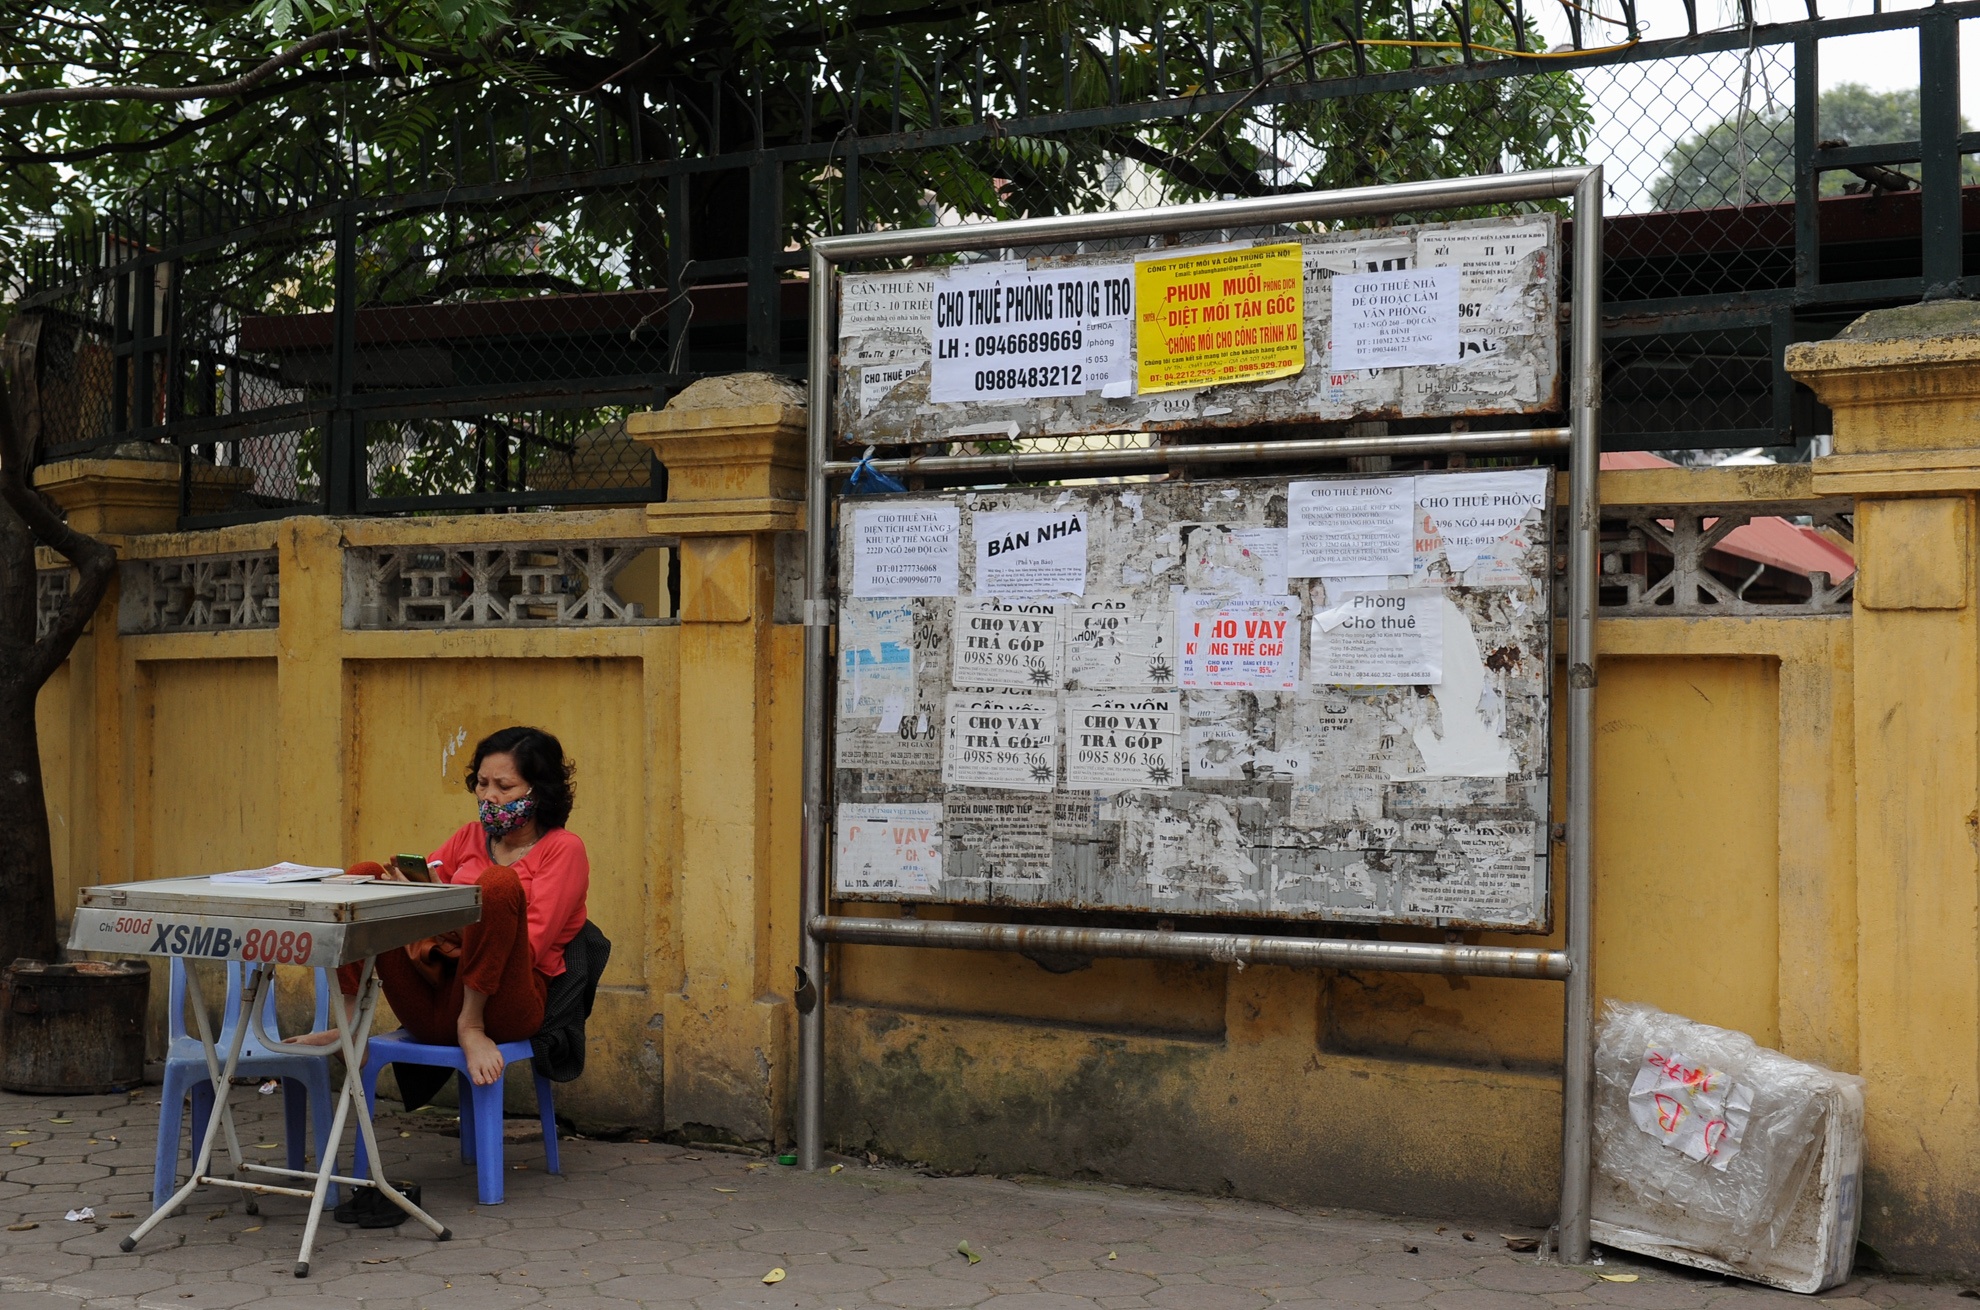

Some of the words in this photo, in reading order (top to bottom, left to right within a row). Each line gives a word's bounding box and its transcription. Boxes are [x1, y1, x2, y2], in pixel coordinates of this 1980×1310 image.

[1484, 246, 1494, 256] TI
[1504, 246, 1515, 255] VI
[1147, 264, 1167, 274] CÔNG
[880, 280, 914, 294] THUÊ
[1166, 282, 1211, 304] PHUN
[1223, 270, 1262, 297] MUỖI
[1306, 286, 1318, 294] 514
[1354, 283, 1378, 294] CHO
[1380, 278, 1411, 292] THUÊ
[1413, 276, 1436, 289] NHÀ
[937, 290, 964, 328] CHO
[968, 280, 1001, 326] THUÊ
[1006, 276, 1053, 323] PHÒNG
[1058, 280, 1084, 327] TRỌ
[1414, 290, 1439, 302] LÀM
[874, 302, 880, 312] 3
[890, 302, 900, 311] 10
[1168, 306, 1199, 328] DIỆT
[1202, 298, 1230, 323] MỐI
[1234, 297, 1262, 322] TẬN
[1266, 290, 1296, 316] GỐC
[1363, 307, 1386, 318] VĂN
[1388, 304, 1428, 317] PHÒNG
[1458, 302, 1482, 318] 967
[939, 339, 959, 360] LH
[976, 329, 1082, 358] 0946689669
[1168, 330, 1196, 355] CHỐNG
[1198, 327, 1214, 350] MỐI
[1216, 330, 1232, 349] CHO
[1235, 326, 1258, 348] CÔNG
[1259, 322, 1284, 344] TRÌNH
[1286, 323, 1298, 341] XD
[1094, 355, 1108, 363] 053
[864, 373, 880, 384] CHO
[883, 368, 903, 382] THUÊ
[975, 364, 1082, 391] 0988483212
[1090, 372, 1109, 380] 0106
[1311, 489, 1332, 497] CHO
[1334, 486, 1359, 496] THUÊ
[1360, 486, 1393, 496] PHÒNG
[1420, 497, 1448, 508] CHO
[1452, 492, 1490, 507] THUÊ
[1494, 492, 1542, 506] PHÒNG
[877, 514, 896, 522] CHO
[896, 512, 919, 522] THUÊ
[920, 512, 938, 522] NHÀ
[1455, 517, 1478, 528] NGÕ
[1480, 519, 1495, 527] 444
[946, 524, 952, 532] 3
[988, 532, 1030, 558] BÁN
[1037, 514, 1082, 544] NHÀ
[866, 536, 884, 544] KHU
[1475, 536, 1495, 545] 0913
[866, 546, 884, 554] 222D
[904, 546, 916, 554] 260
[1354, 594, 1406, 611] Phòng
[971, 617, 1004, 631] CHO
[1008, 619, 1044, 633] VAY
[1244, 620, 1288, 639] VAY
[1342, 616, 1376, 629] Cho
[1382, 614, 1416, 629] thuê
[966, 632, 1000, 650] TRẢ
[1008, 636, 1044, 652] GÓP
[1232, 639, 1256, 656] THẾ
[964, 651, 993, 665] 0985
[996, 652, 1018, 666] 896
[1022, 654, 1045, 668] 366
[968, 716, 1002, 730] CHO
[1006, 718, 1042, 730] VAY
[1084, 715, 1119, 728] CHO
[1124, 716, 1161, 730] VAY
[964, 730, 1000, 748] TRẢ
[1080, 730, 1117, 748] TRẢ
[1124, 732, 1162, 750] GÓP
[964, 750, 993, 764] 0985
[997, 751, 1020, 764] 896
[1024, 752, 1046, 765] 366
[1078, 750, 1109, 764] 0985
[1113, 751, 1136, 764] 896
[1140, 752, 1164, 766] 366
[892, 827, 930, 845] VAY
[149, 923, 233, 958] XSMB
[242, 928, 313, 965] 8089
